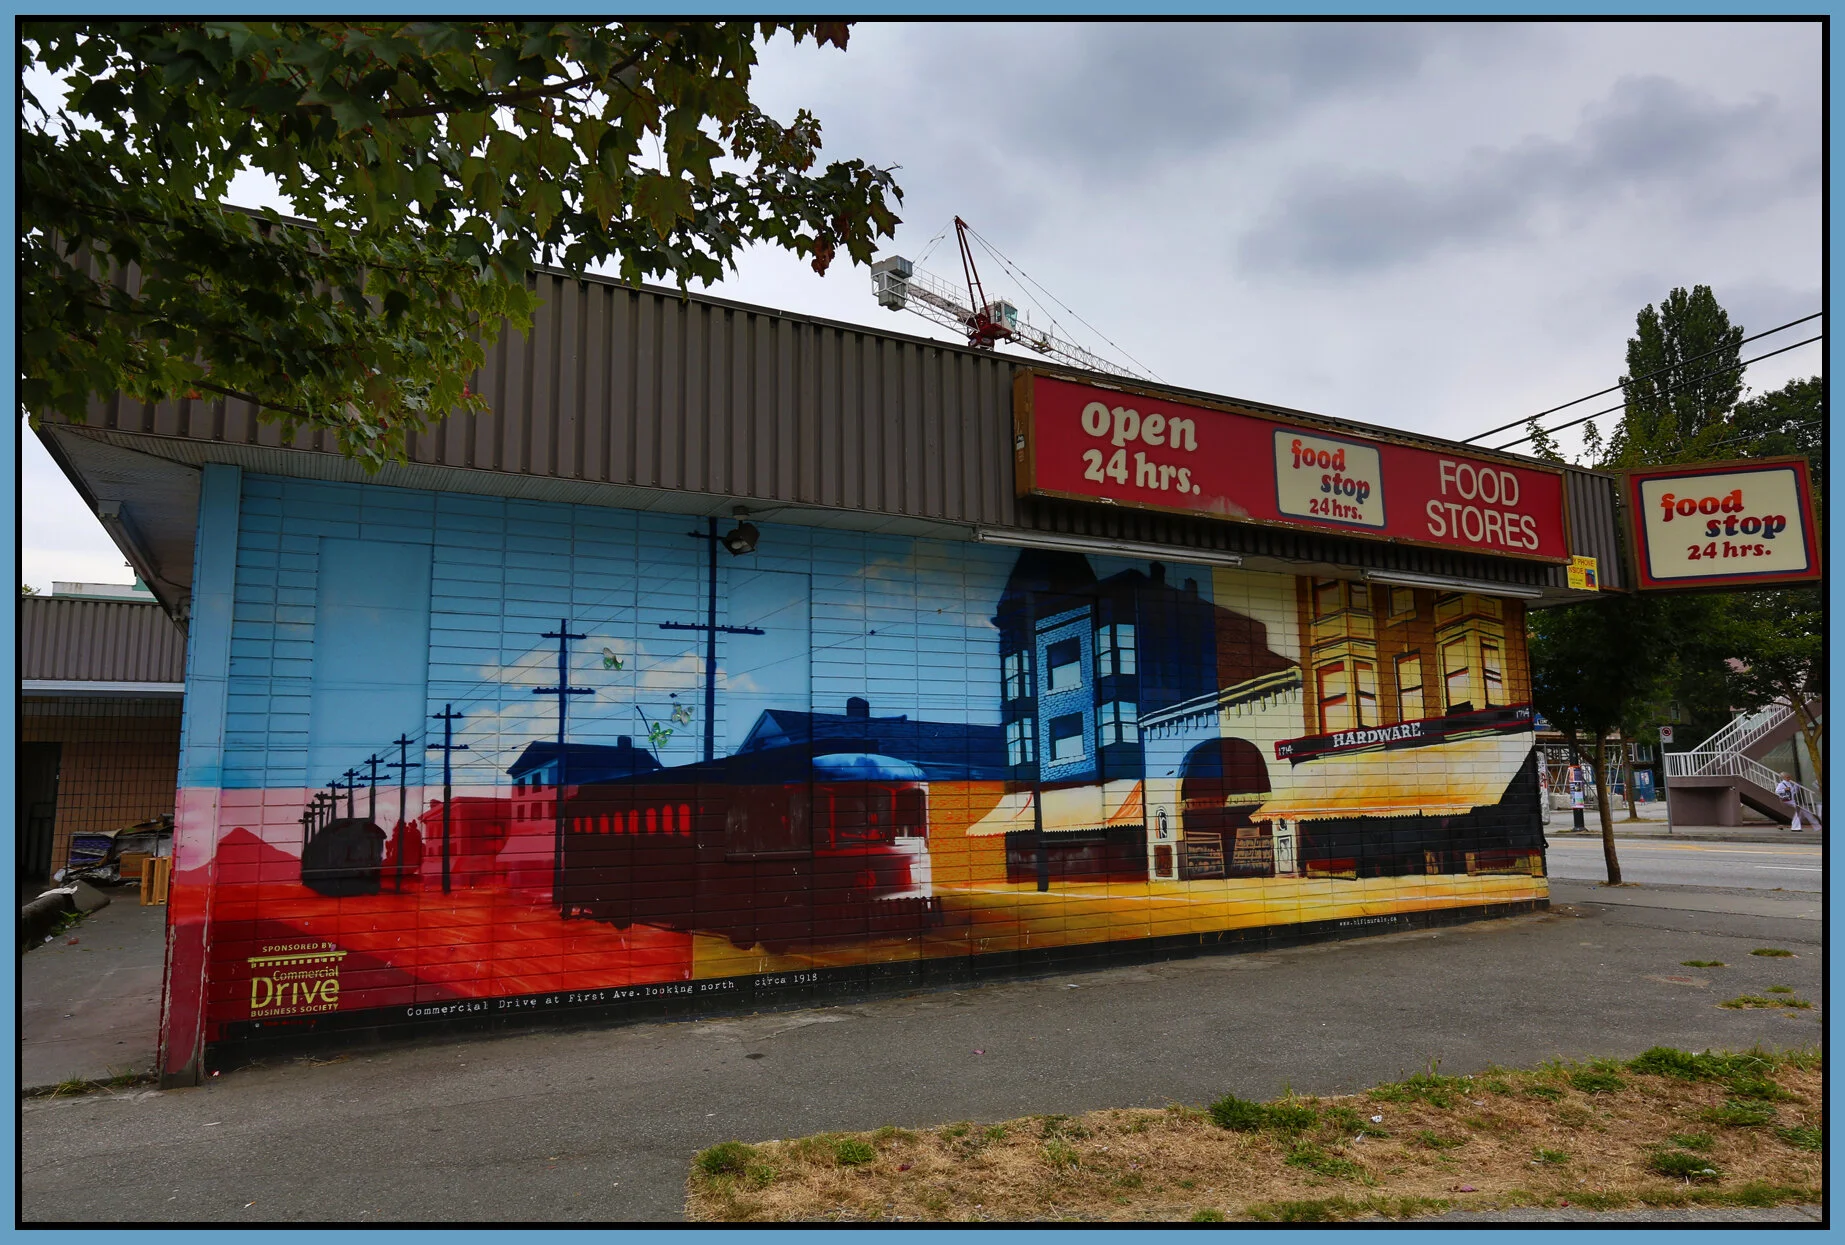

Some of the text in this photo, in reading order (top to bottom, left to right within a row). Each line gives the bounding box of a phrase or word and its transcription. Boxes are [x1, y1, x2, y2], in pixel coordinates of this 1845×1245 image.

[1081, 401, 1198, 452] open
[1082, 448, 1201, 495] 24 hrs.
[1291, 439, 1346, 473] food
[1320, 472, 1371, 504] stop
[1439, 459, 1520, 507] FOOD
[1309, 497, 1363, 520] 24 hrs.
[1660, 489, 1745, 522] food
[1426, 499, 1539, 550] STORES
[1704, 514, 1787, 539] stop
[1687, 541, 1772, 561] 24 hrs.
[262, 941, 333, 953] SPONSORED BY
[273, 966, 339, 981] Commercial
[251, 977, 340, 1009] Drive
[407, 972, 818, 1017] Commercial Drive at First Ave. looking north circa 1918
[251, 1003, 339, 1017] BUSINESS SOCIETY
